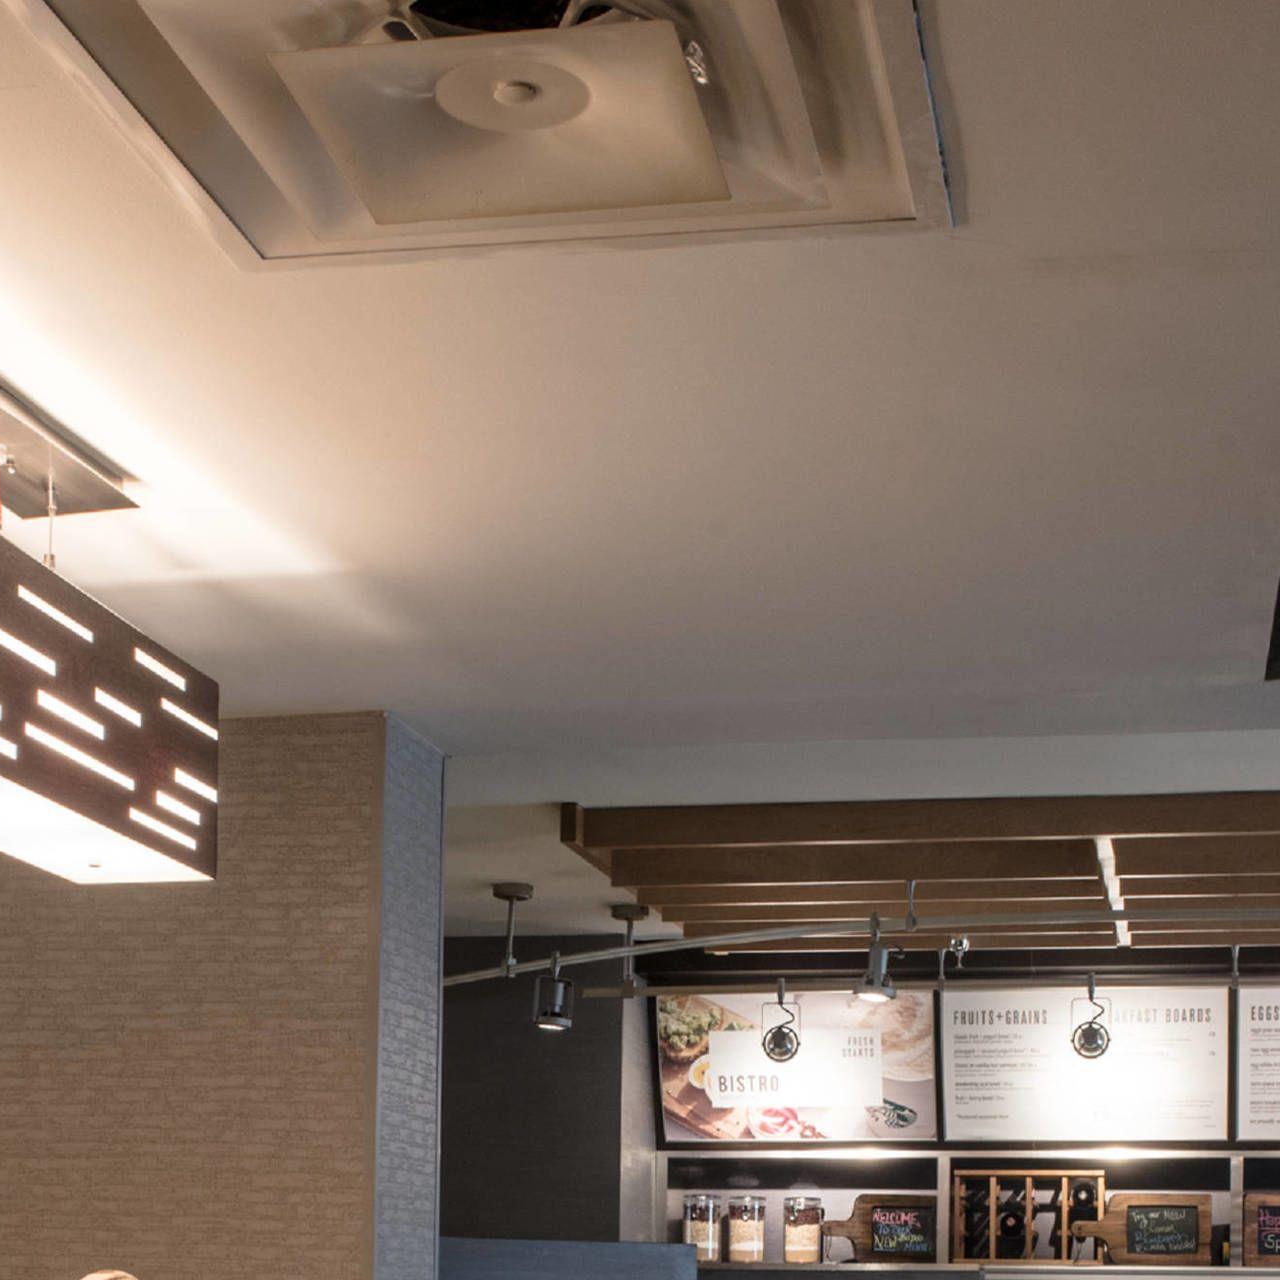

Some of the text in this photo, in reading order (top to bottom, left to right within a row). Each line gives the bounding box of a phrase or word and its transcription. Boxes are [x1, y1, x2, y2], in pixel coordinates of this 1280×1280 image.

[952, 1008, 1049, 1026] FRUITS+GRAINS
[1164, 1007, 1212, 1023] BOARDS
[1250, 1005, 1280, 1022] EGGS
[847, 1036, 875, 1047] FRESH
[841, 1047, 875, 1058] STARTS
[717, 1074, 780, 1093] BISTRO
